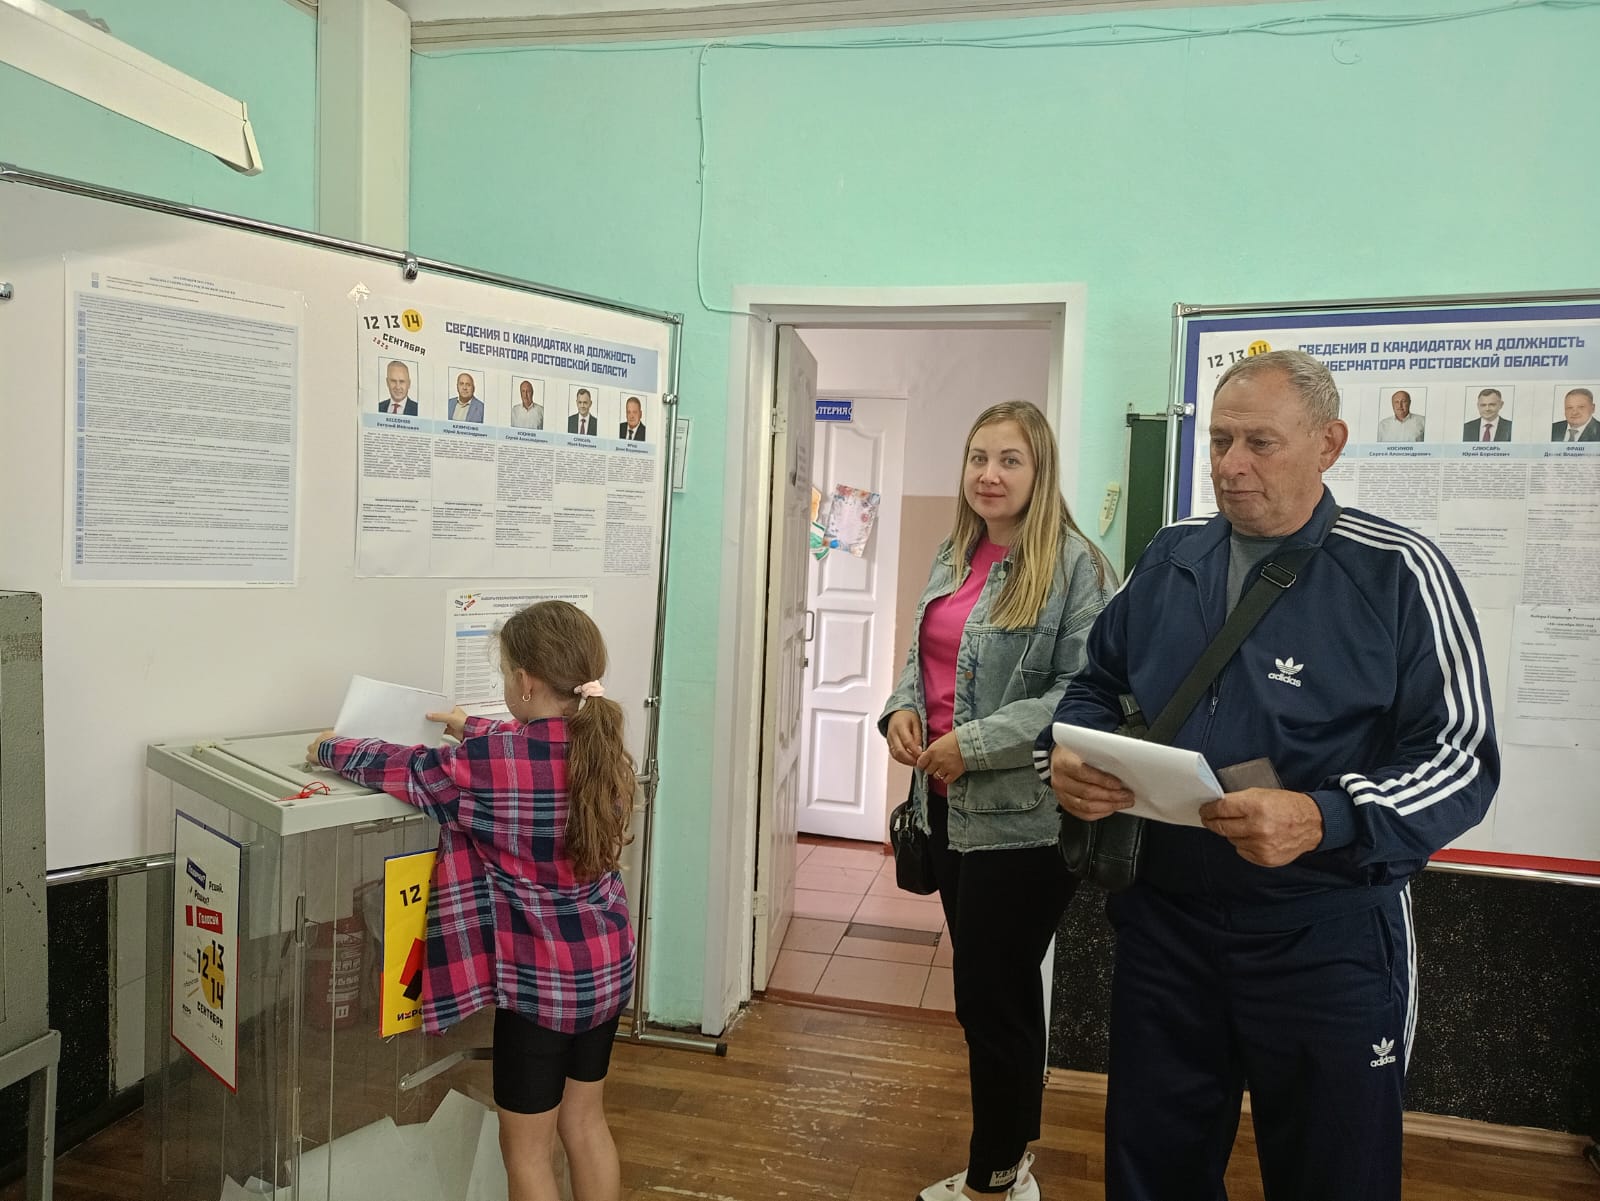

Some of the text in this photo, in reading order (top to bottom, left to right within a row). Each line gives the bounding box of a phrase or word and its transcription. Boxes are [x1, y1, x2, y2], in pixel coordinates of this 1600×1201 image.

[363, 314, 420, 330] 12 13 14
[382, 332, 426, 356] СЕНТЯБРЯ
[445, 321, 636, 365] СВЕДЕНИЯ О КАНДИДАТАХ НА ДОЛЖНОСТЬ
[1370, 341, 1380, 354] О
[1383, 339, 1471, 354] КАНДИДАТАХ
[1474, 338, 1493, 350] НА
[1495, 336, 1585, 351] ДОЛЖНОСТЬ
[459, 341, 628, 378] ГУБЕРНАТОРА РОСТОВСКОЙ ОБЛАСТИ
[1207, 354, 1224, 369] 12
[1228, 349, 1245, 363] 13
[1409, 353, 1500, 370] РОСТОВСКОЙ
[1503, 354, 1569, 368] ОБЛАСТИ
[1267, 672, 1302, 687] adidas
[399, 883, 422, 907] 12
[196, 948, 209, 980] 12
[211, 939, 225, 972] 13
[210, 977, 224, 1010] 14
[197, 1000, 224, 1030] СЕНТЯБРЯ
[1370, 1055, 1396, 1068] adidas
